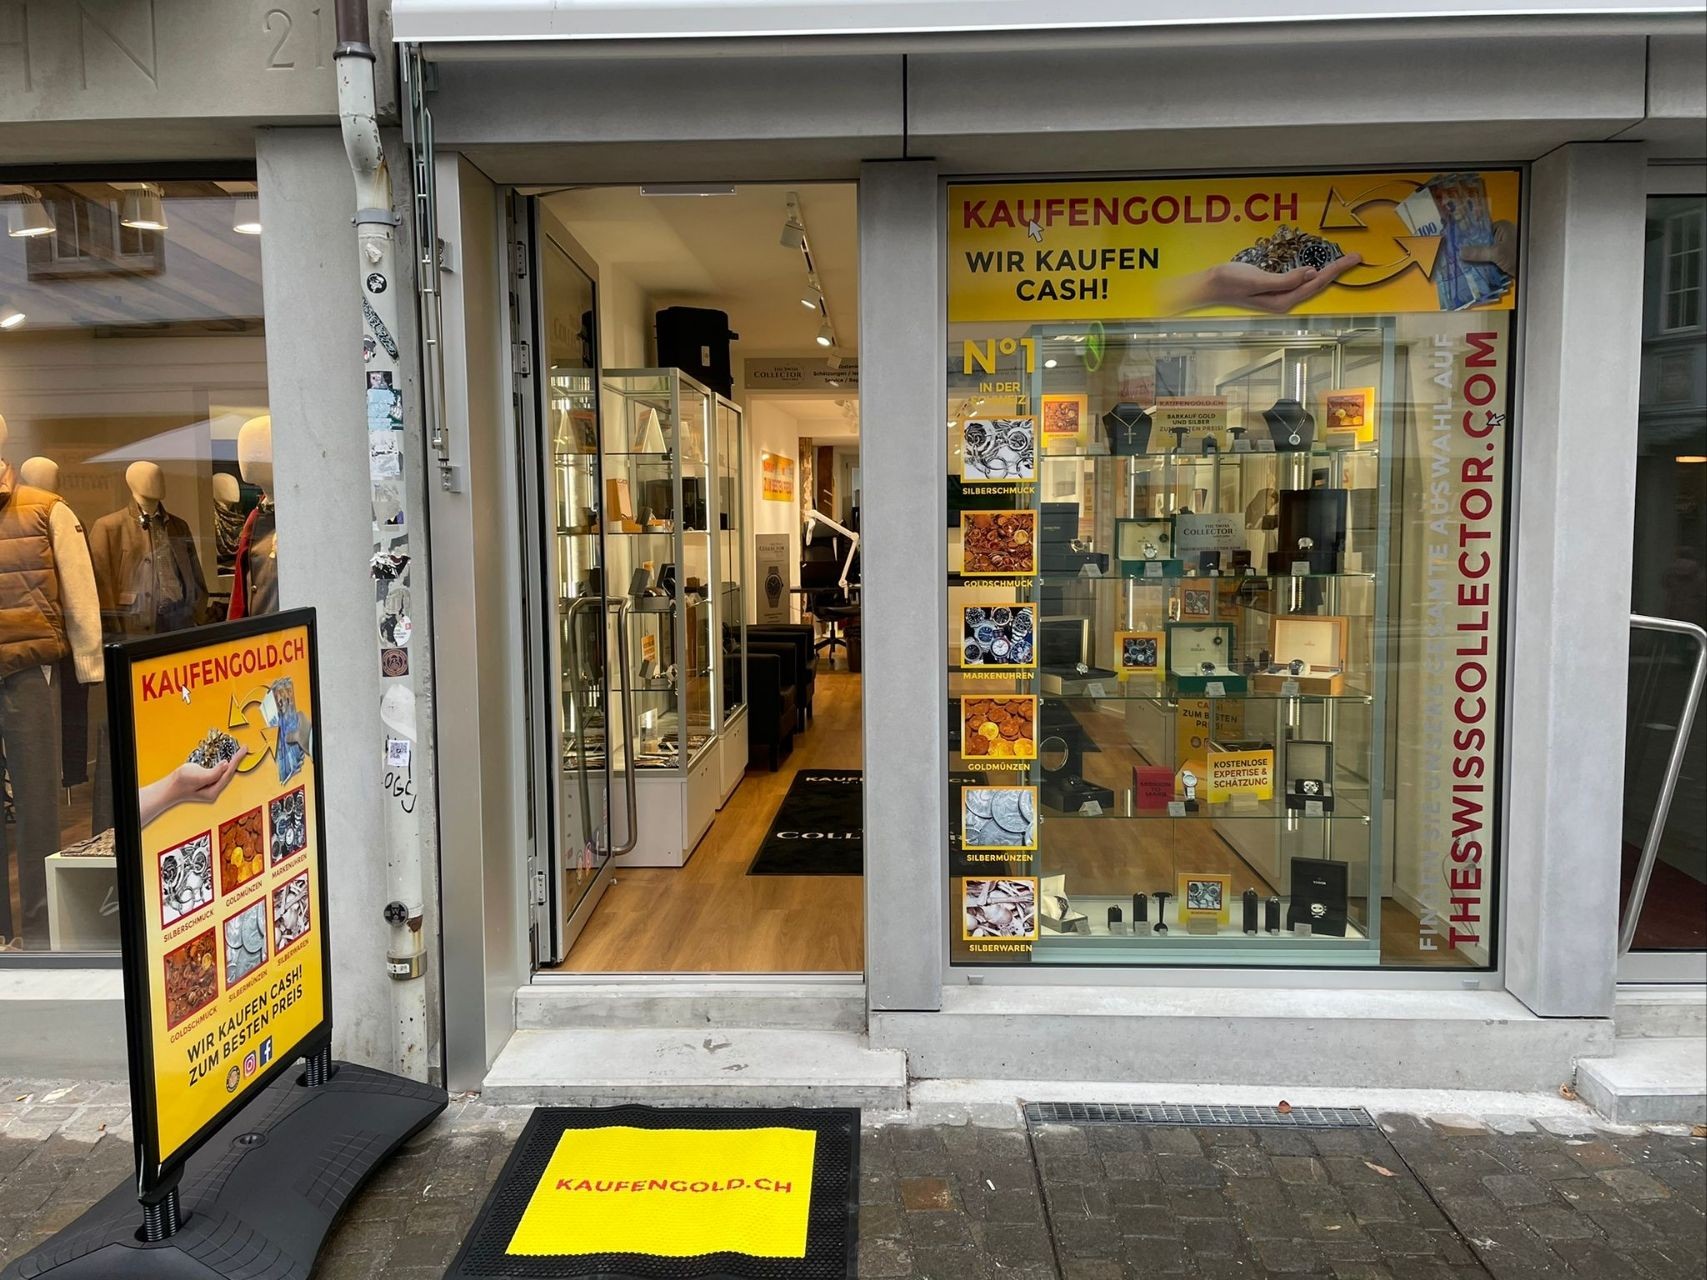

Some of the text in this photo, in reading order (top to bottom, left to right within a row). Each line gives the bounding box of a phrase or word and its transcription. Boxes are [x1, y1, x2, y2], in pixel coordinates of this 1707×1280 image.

[262, 8, 327, 71] 21
[963, 192, 1299, 229] KAUFENGOLD.CH
[965, 247, 1160, 273] WIR KAUFEN
[1016, 277, 1109, 301] CASH!
[1433, 333, 1455, 388] AUF
[979, 381, 1021, 393] IN DER
[1430, 394, 1454, 535] AUSWAHL
[962, 486, 1035, 495] SILBERSCHMUCK
[1183, 527, 1234, 536] COLLECTOR
[963, 580, 1034, 588] GOLDSCHMUCK
[1449, 331, 1498, 950] THESWISSCOLLECTOR.COM
[141, 636, 305, 702] KAUFENGOLD.CH
[962, 671, 1035, 680] MARKENUHREN
[1183, 709, 1238, 723] ZUM BSTEN
[967, 762, 1031, 771] GOLDMÜNZEN
[1213, 758, 1268, 769] KOSTENLOSE
[1213, 767, 1268, 779] EXPERTISE &
[1213, 777, 1268, 789] SCHÄTZUNG
[271, 853, 308, 878] MARKENUHREN
[966, 852, 1034, 862] SILBERMÜNZEN
[225, 880, 263, 907] GOLDMÜNZEN
[163, 908, 215, 943] SILBERSCHMUCK
[276, 938, 310, 966] SILBERWAREN
[969, 944, 1033, 953] SILBERWAREN
[228, 969, 268, 1002] SILBERMÜNZEN
[170, 1005, 218, 1043] GOLDSCHMUCK
[186, 963, 303, 1064] WIR KAUFEN CASH!
[189, 983, 303, 1087] ZUM BESTEN PREIS
[555, 1177, 793, 1194] KAUFENGOLD.CH
